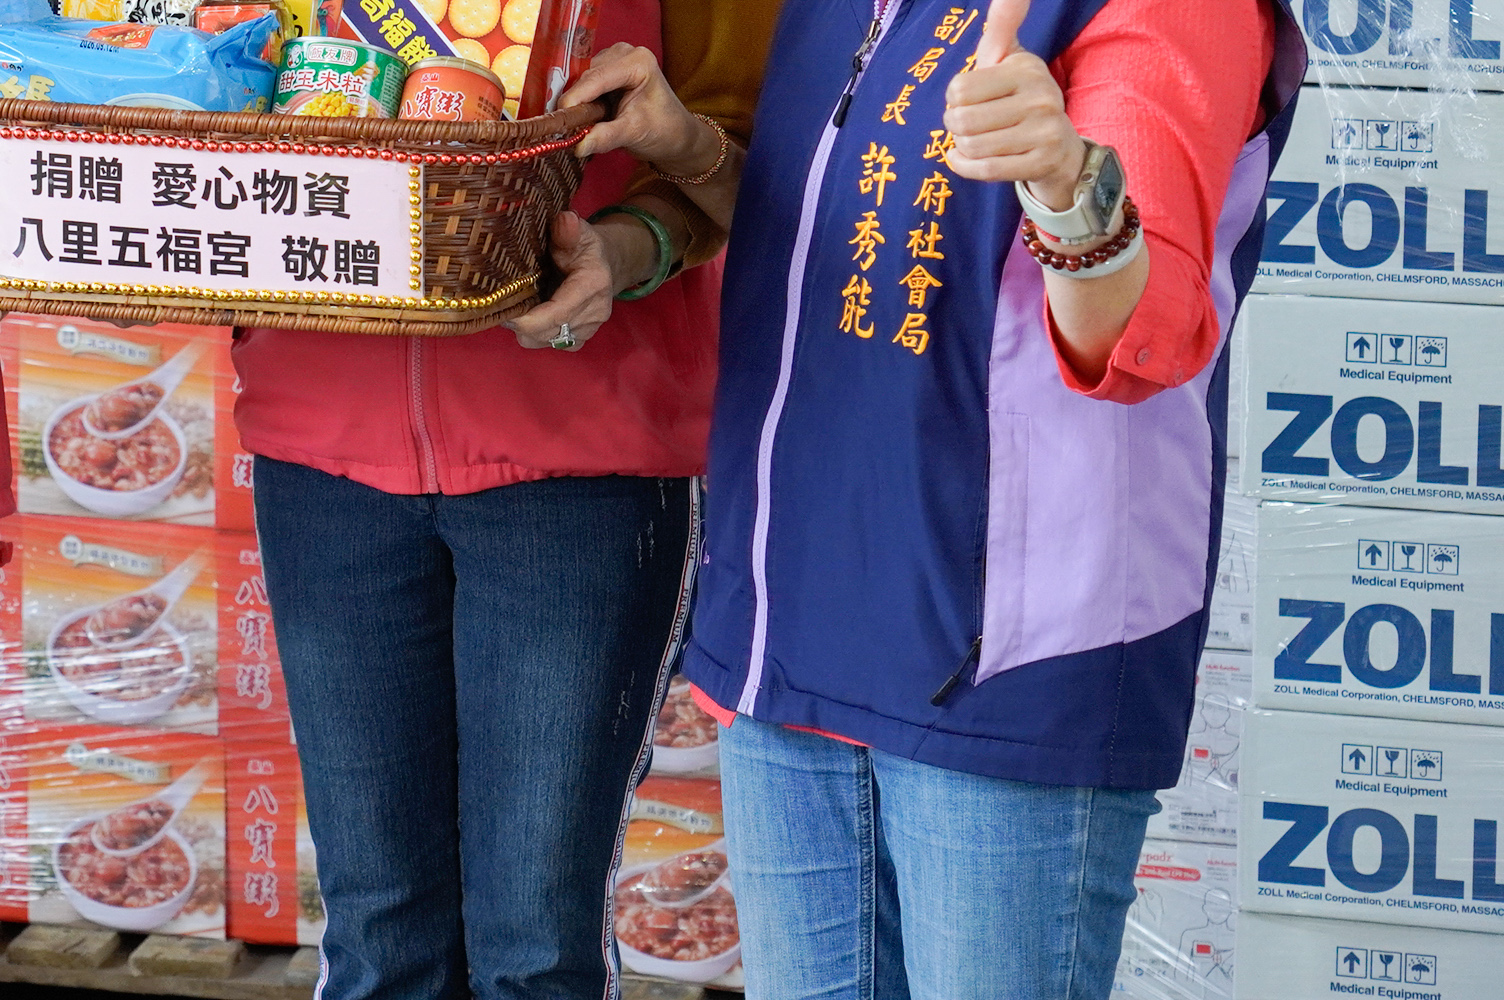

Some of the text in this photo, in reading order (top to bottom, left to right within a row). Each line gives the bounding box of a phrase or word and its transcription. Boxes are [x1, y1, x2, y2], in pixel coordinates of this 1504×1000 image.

[881, 6, 979, 126] 副局長
[279, 70, 365, 96] 甜玉米粒
[1325, 154, 1438, 170] Medical Equipment
[29, 150, 351, 220] 捐贈 愛心物資
[12, 217, 381, 288] 八里五福宮 敬贈
[1276, 268, 1311, 279] Medical
[1315, 270, 1374, 282] Corporation,
[1376, 272, 1450, 286] CHELMSFORD,
[1452, 275, 1504, 288] MASSACH
[1339, 367, 1453, 384] Medical Equipment
[1290, 480, 1326, 491] Medical
[1329, 483, 1388, 497] Corporation,
[1390, 486, 1464, 500] CHELMSFORD,
[1351, 574, 1465, 592] Medical Equipment
[1274, 684, 1300, 695] ZOLL
[1302, 687, 1339, 698] Medical
[1341, 689, 1401, 702] Corporation,
[1402, 693, 1476, 708] CHELMSFORD,
[1335, 779, 1448, 798] Medical Equipment
[243, 784, 280, 918] 八寶粥
[1258, 886, 1284, 898] ZOLL
[1286, 890, 1323, 901] Medical
[1325, 893, 1384, 906] Corporation,
[1386, 897, 1459, 912] CHELMSFORD,
[1330, 982, 1442, 1000] Medical Equipment
